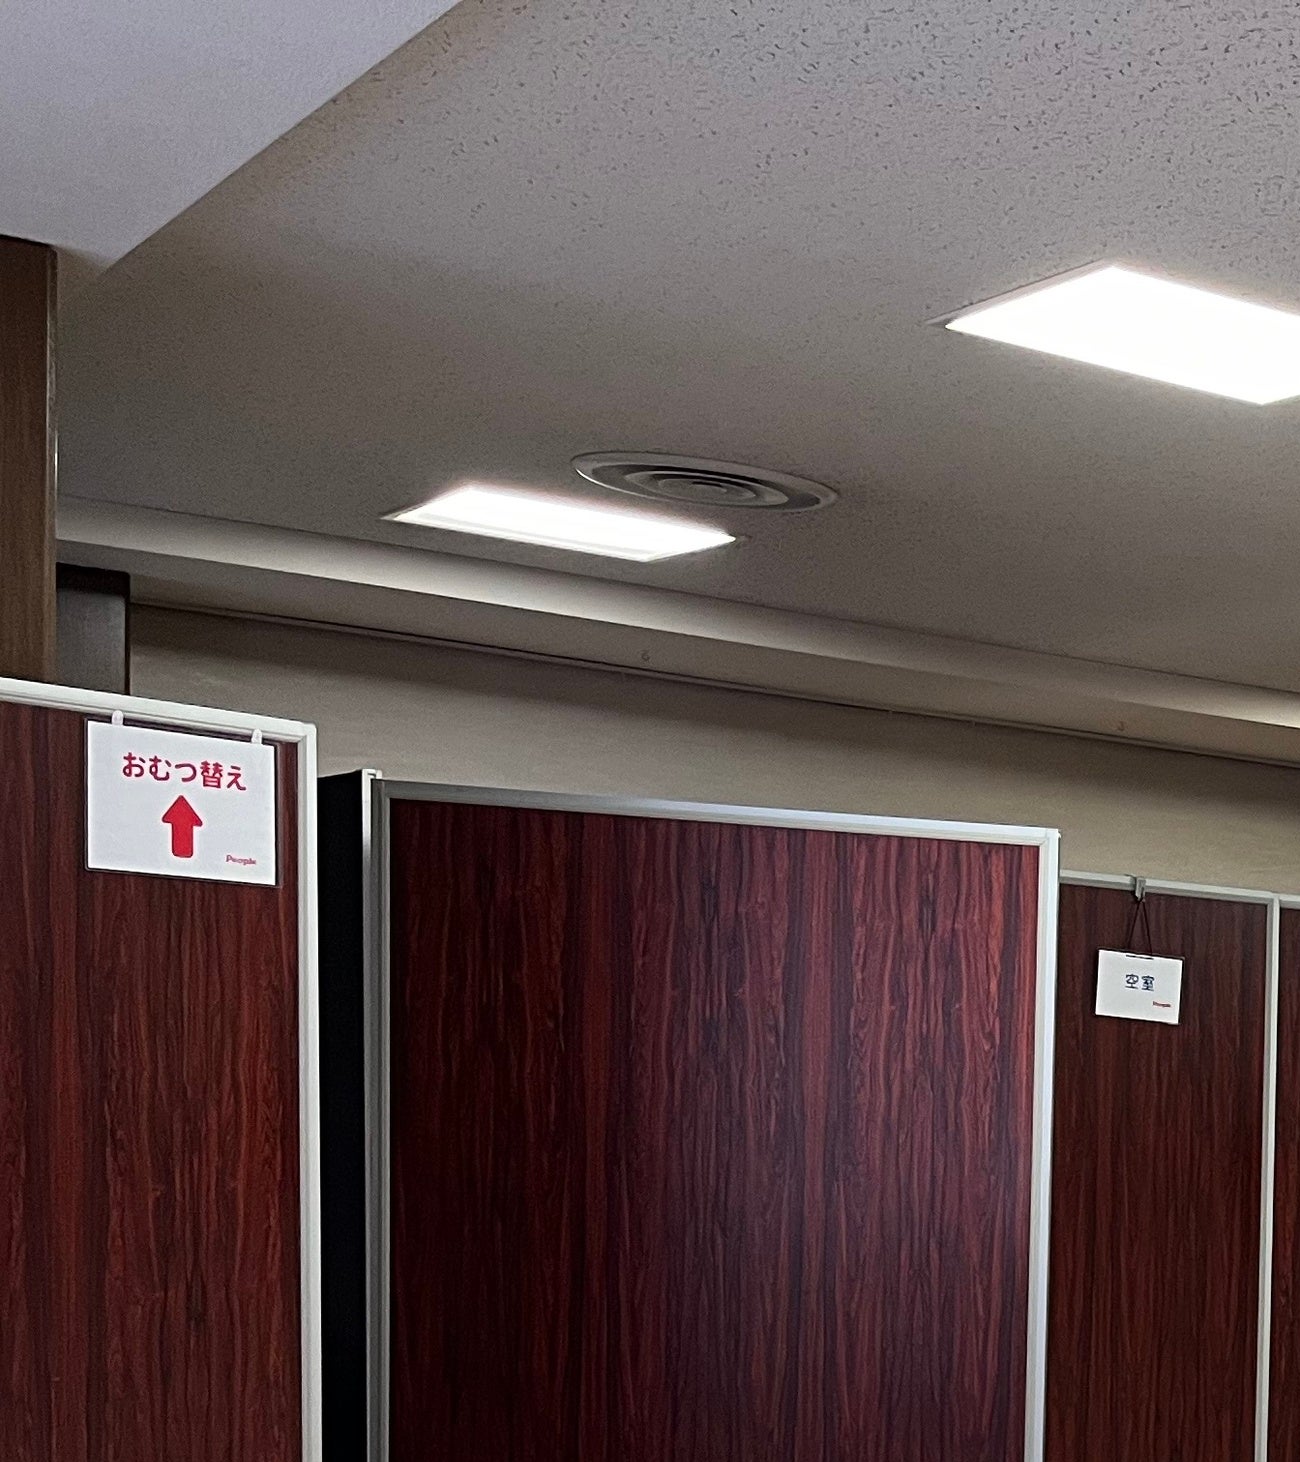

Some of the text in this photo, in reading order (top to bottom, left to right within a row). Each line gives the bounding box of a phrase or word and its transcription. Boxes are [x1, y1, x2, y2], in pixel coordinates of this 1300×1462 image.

[122, 752, 247, 791] おむつ替え
[225, 854, 257, 866] People
[1125, 973, 1155, 992] 空室
